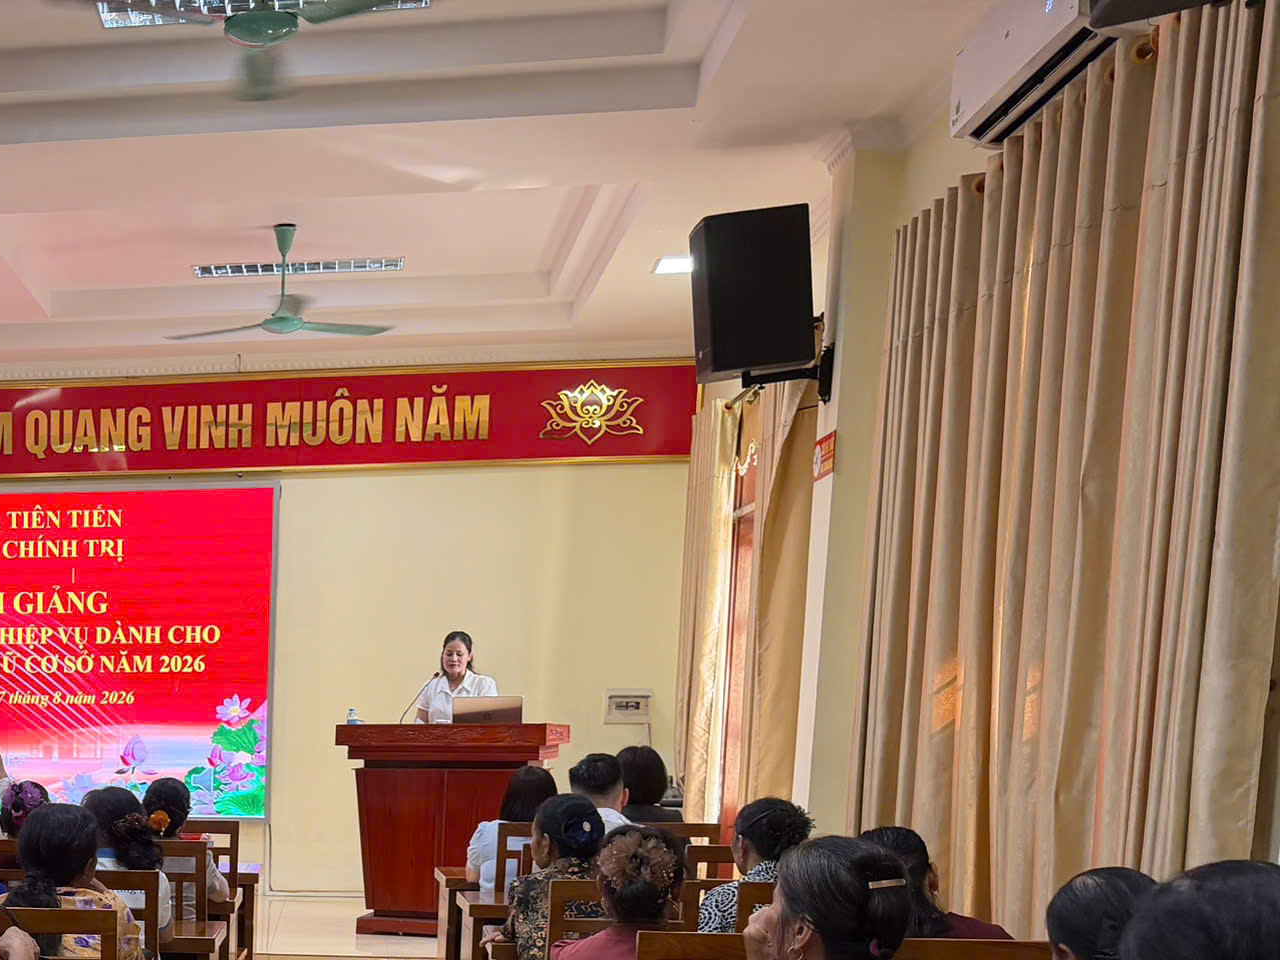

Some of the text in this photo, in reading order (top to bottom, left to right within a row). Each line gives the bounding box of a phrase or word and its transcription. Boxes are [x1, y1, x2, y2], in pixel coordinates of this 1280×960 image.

[25, 405, 151, 457] QUANG
[162, 403, 253, 451] VINH
[266, 388, 382, 447] MUÔN
[395, 384, 490, 442] NĂM
[6, 504, 61, 529] TIÊN
[2, 534, 77, 559] CHÍNH
[84, 538, 125, 562] TRỊ
[13, 585, 109, 614] GIẢNG
[57, 626, 89, 650] VỤ
[96, 620, 161, 645] DÀNH
[167, 625, 221, 644] CHO
[25, 655, 59, 673] CƠ
[63, 649, 95, 673] SỞ
[99, 650, 152, 673] NĂM
[159, 655, 206, 673] 2026
[9, 690, 50, 708] tháng
[65, 691, 96, 705] năm
[100, 690, 135, 705] 2026
